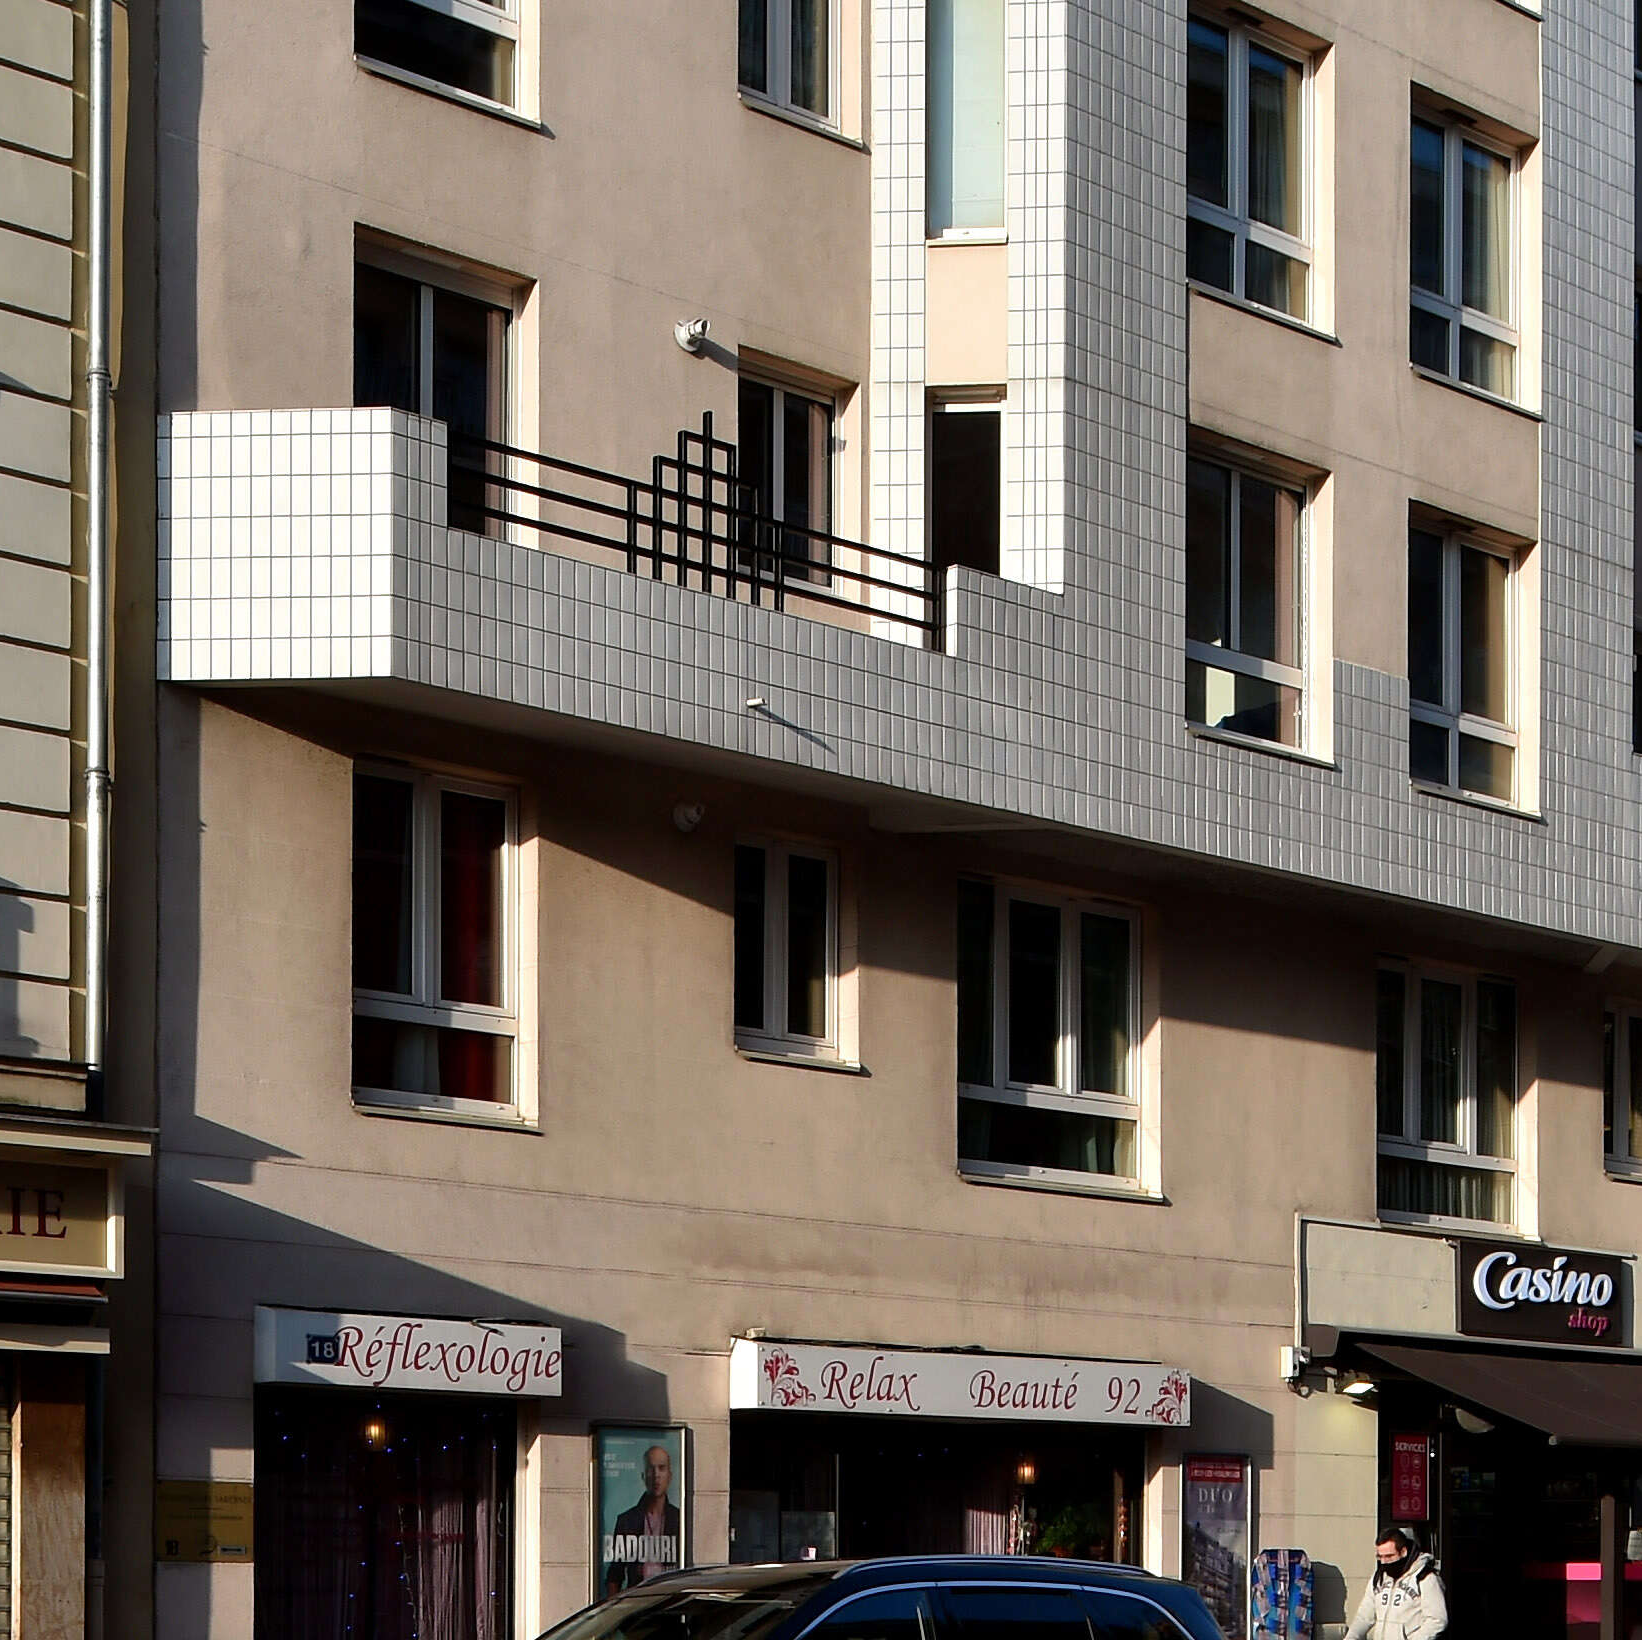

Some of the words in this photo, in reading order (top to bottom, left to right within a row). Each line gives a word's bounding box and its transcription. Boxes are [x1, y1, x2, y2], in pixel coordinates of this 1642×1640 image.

[1473, 1251, 1613, 1309] Casino
[1568, 1307, 1608, 1336] shop
[310, 1341, 335, 1358] 18
[334, 1323, 562, 1392] Réflexologie
[821, 1356, 921, 1411] Relax
[970, 1370, 1080, 1410] Beauté
[1104, 1376, 1142, 1415] 92
[1395, 1442, 1426, 1453] SERVICES
[1198, 1487, 1233, 1503] DUO
[603, 1535, 677, 1563] BADOURI
